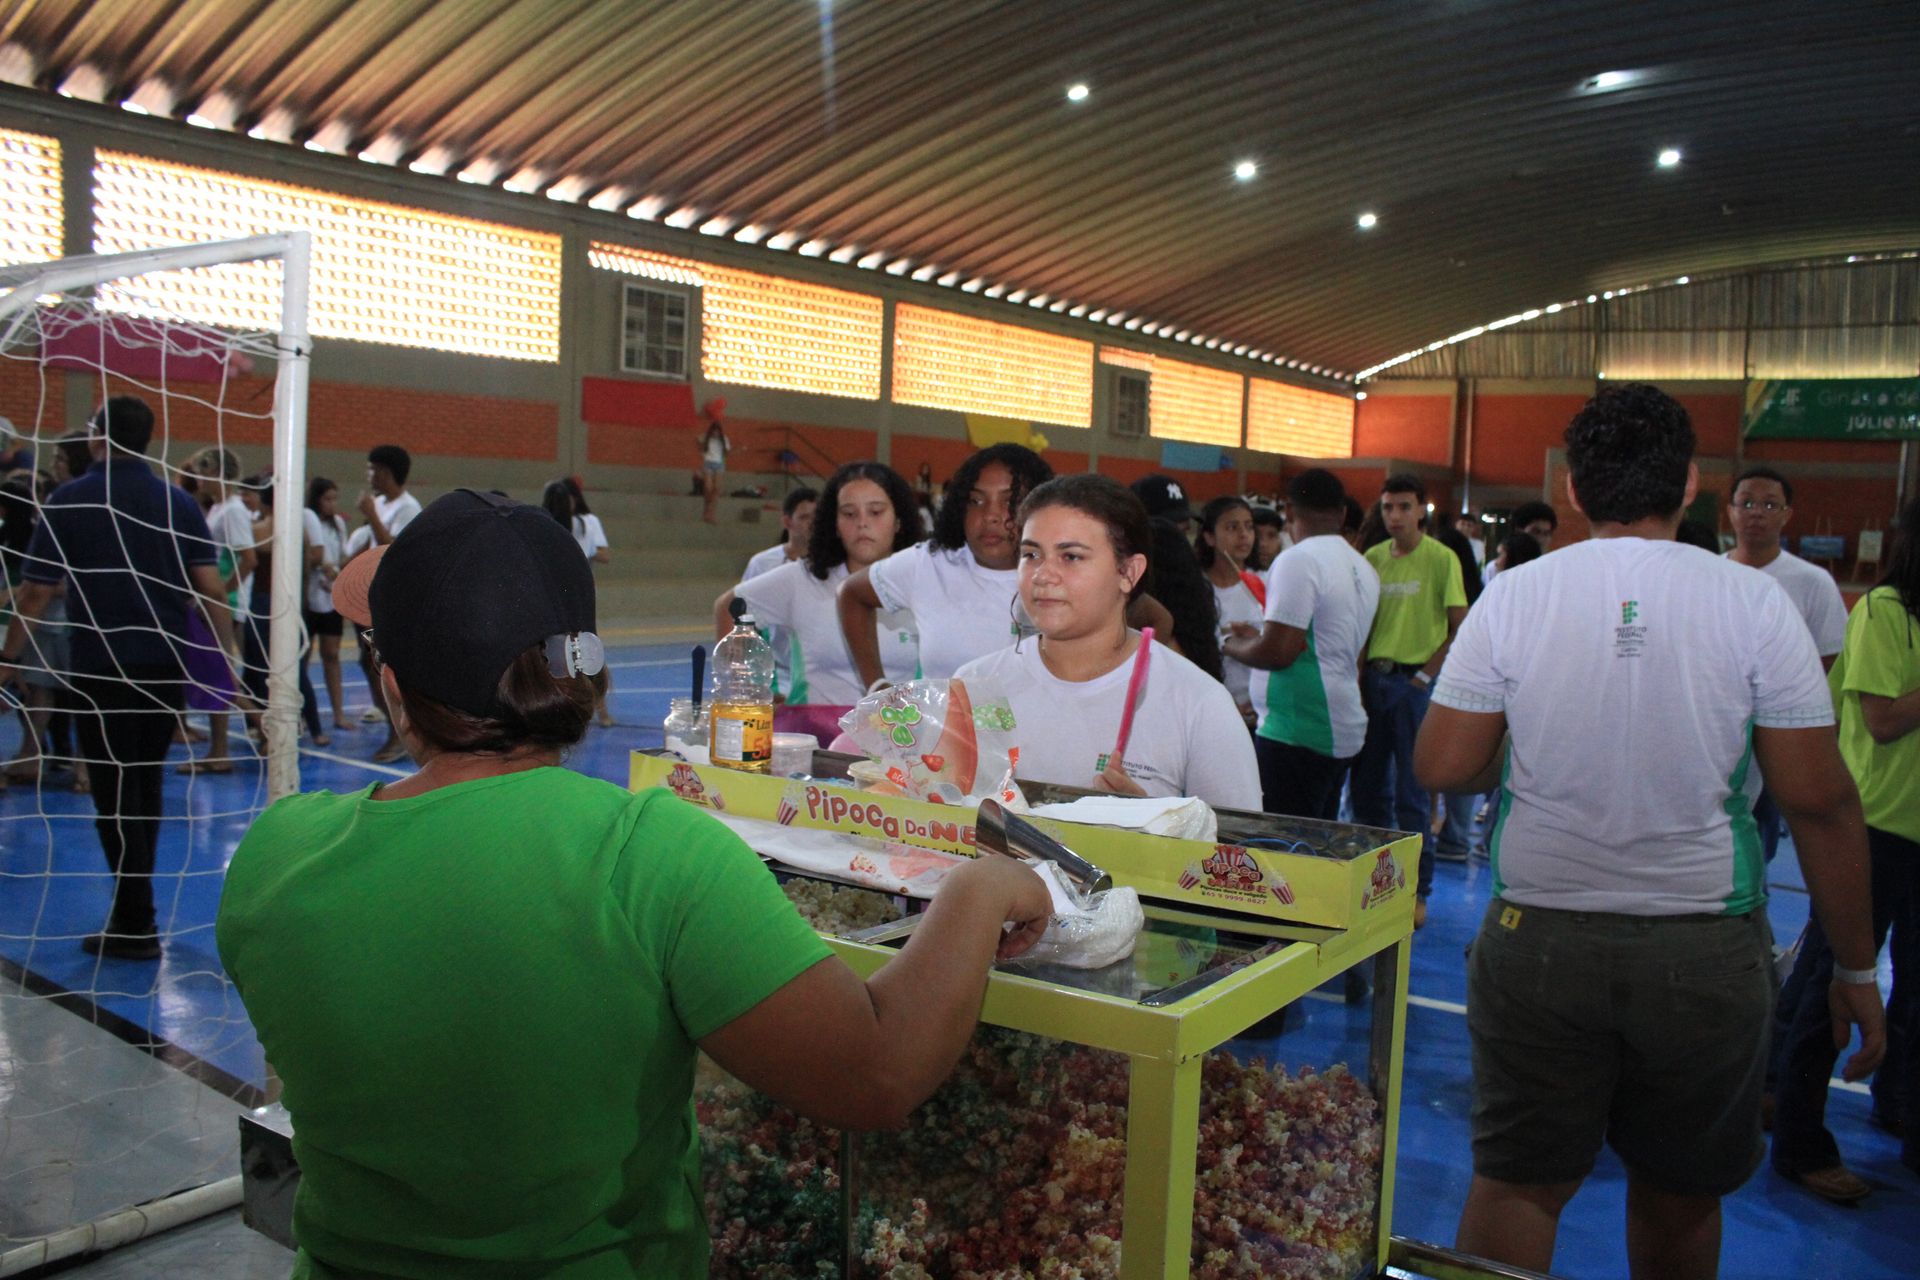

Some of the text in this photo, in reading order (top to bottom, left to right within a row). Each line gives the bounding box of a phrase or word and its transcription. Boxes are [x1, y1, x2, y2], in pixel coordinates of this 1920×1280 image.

[805, 785, 900, 839] Pipoca
[905, 819, 927, 837] Da
[928, 820, 977, 847] NE
[1202, 858, 1261, 882] Pipoca
